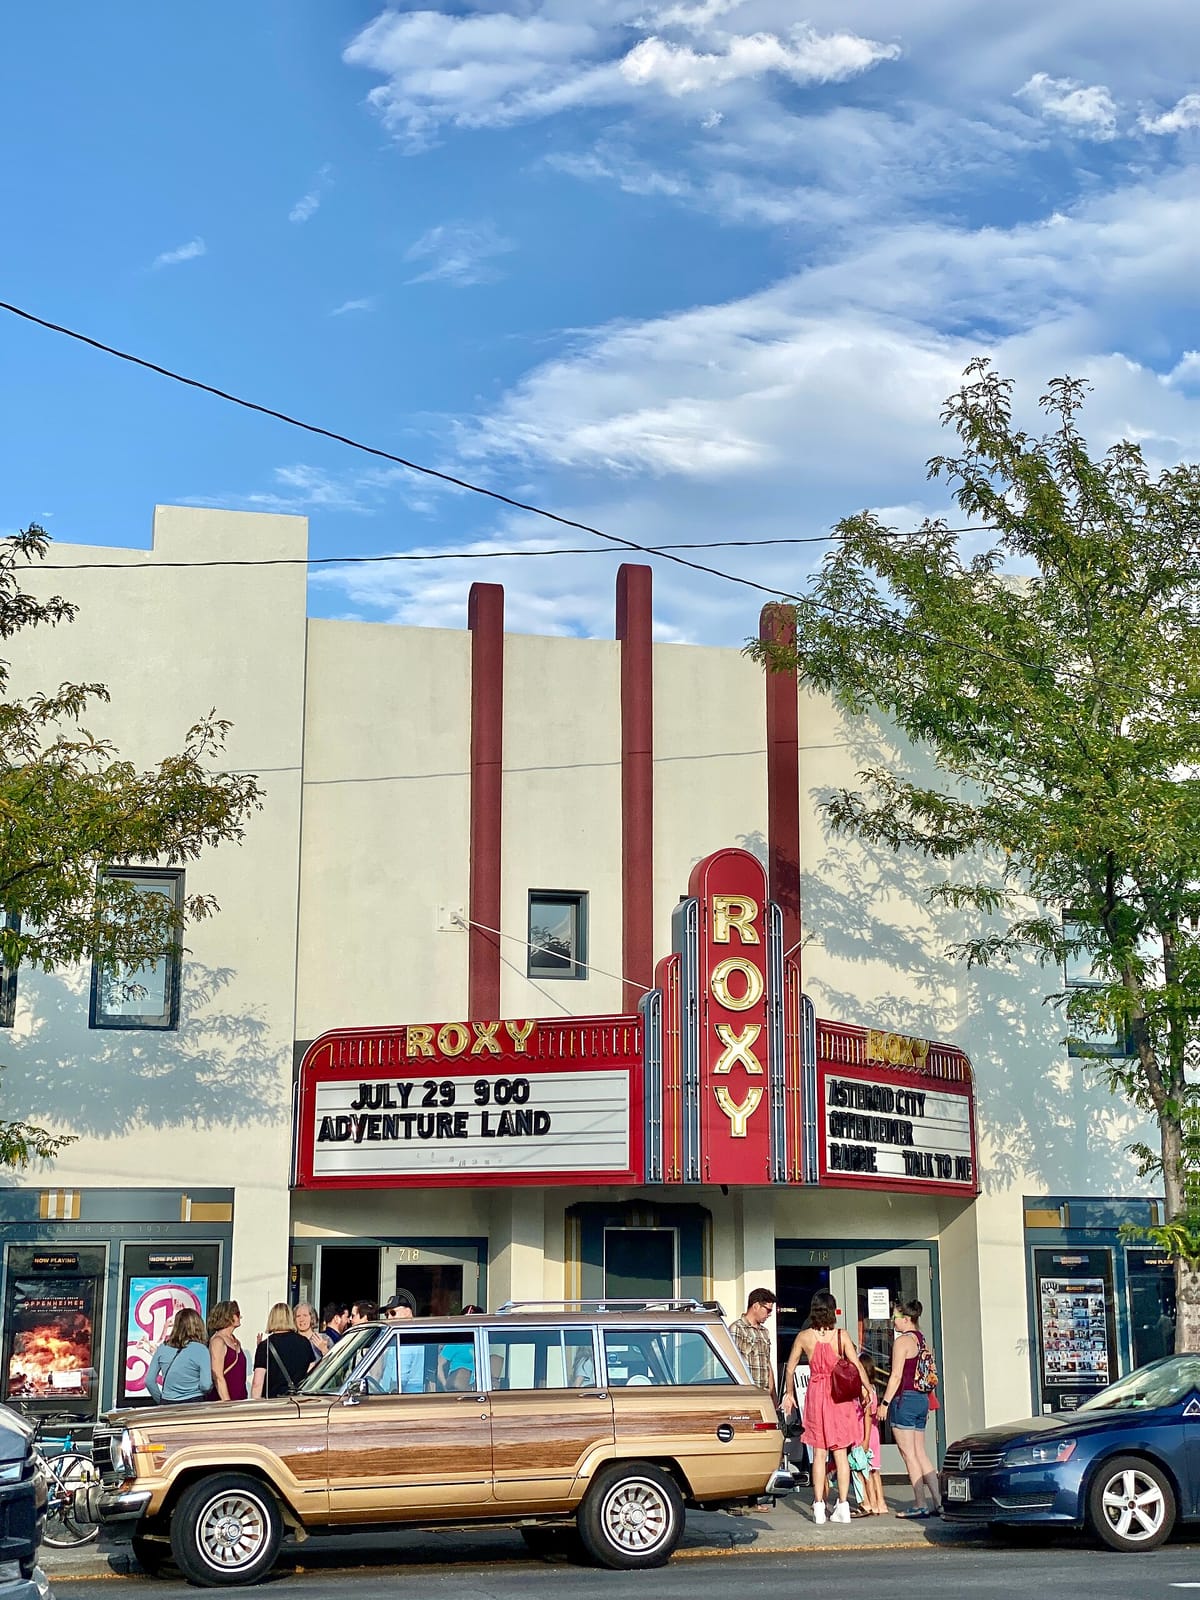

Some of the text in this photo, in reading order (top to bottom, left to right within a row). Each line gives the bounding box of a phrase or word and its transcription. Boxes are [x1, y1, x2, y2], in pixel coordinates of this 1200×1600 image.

[711, 894, 764, 1138] ROXY
[405, 1020, 537, 1058] ROXY
[866, 1030, 929, 1067] ROXY
[351, 1078, 530, 1110] JULY 29 900
[829, 1079, 926, 1117] ASTEROID CITY
[317, 1109, 551, 1143] ADVENTURE LAND
[829, 1111, 914, 1146] OPPENHEIMER
[829, 1142, 878, 1172] BARBIE
[902, 1150, 935, 1178] TALK
[934, 1154, 952, 1179] TO
[399, 1249, 420, 1261] 718
[808, 1250, 829, 1262] 718
